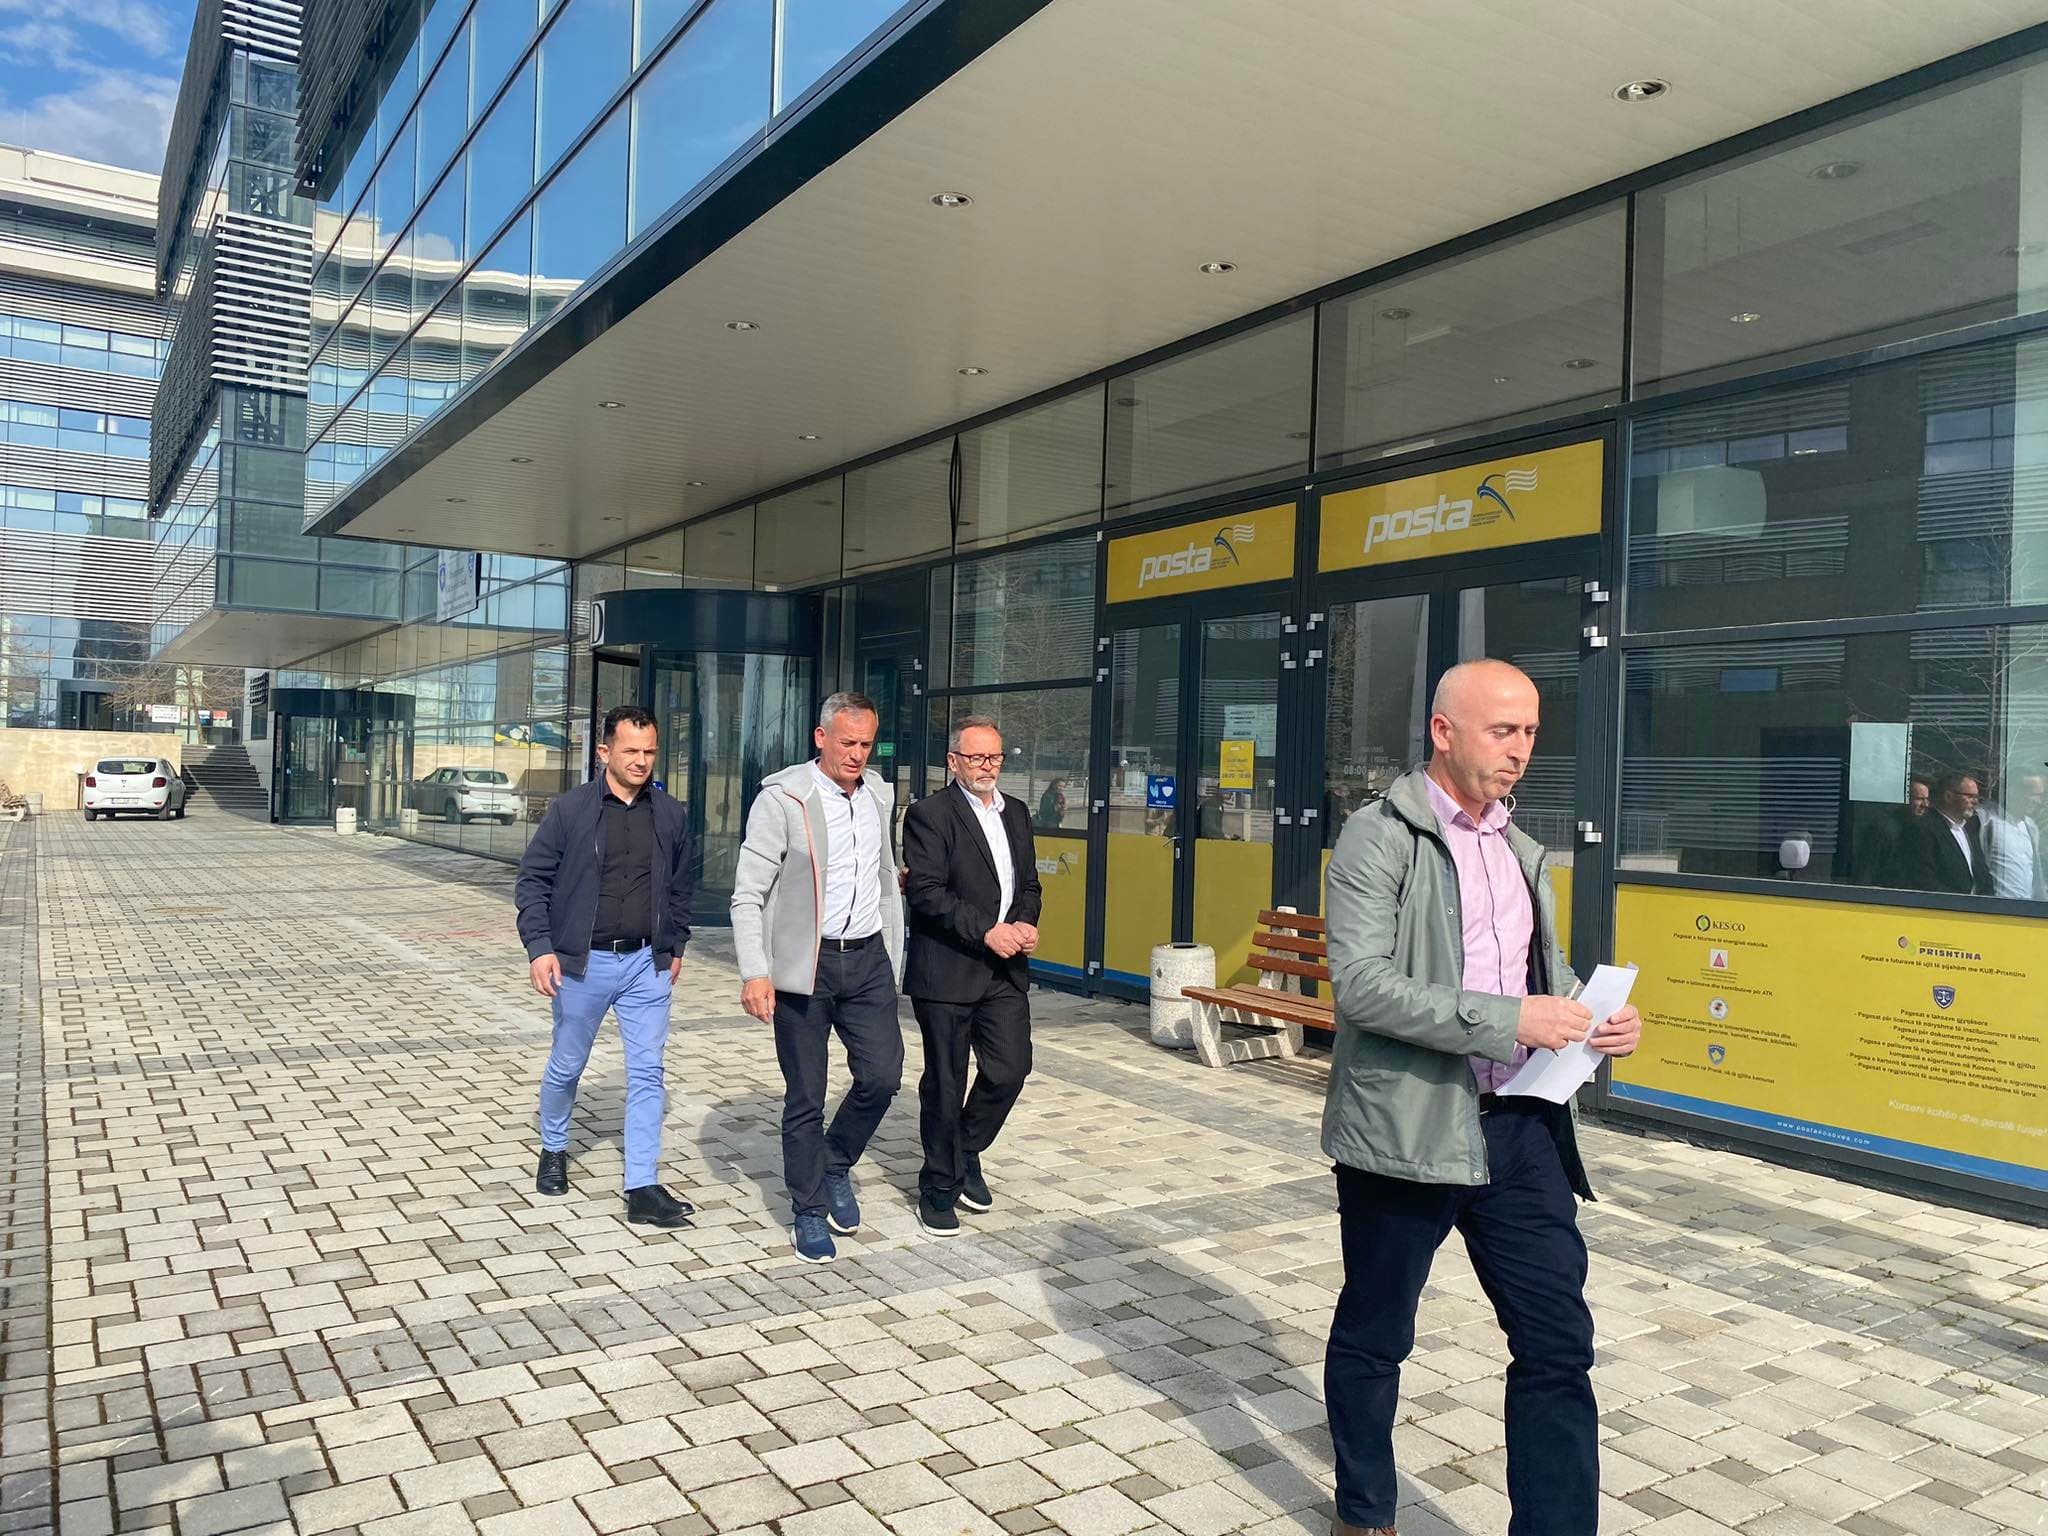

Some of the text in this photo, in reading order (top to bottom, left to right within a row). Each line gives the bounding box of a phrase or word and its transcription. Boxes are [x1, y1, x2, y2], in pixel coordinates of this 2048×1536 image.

[1363, 494, 1473, 553] posta
[1138, 542, 1212, 589] posta
[592, 602, 604, 644] D
[1920, 948, 1981, 960] PRISHTINA
[1888, 1098, 1926, 1114] Kurseni
[1960, 1112, 1979, 1125] dhe
